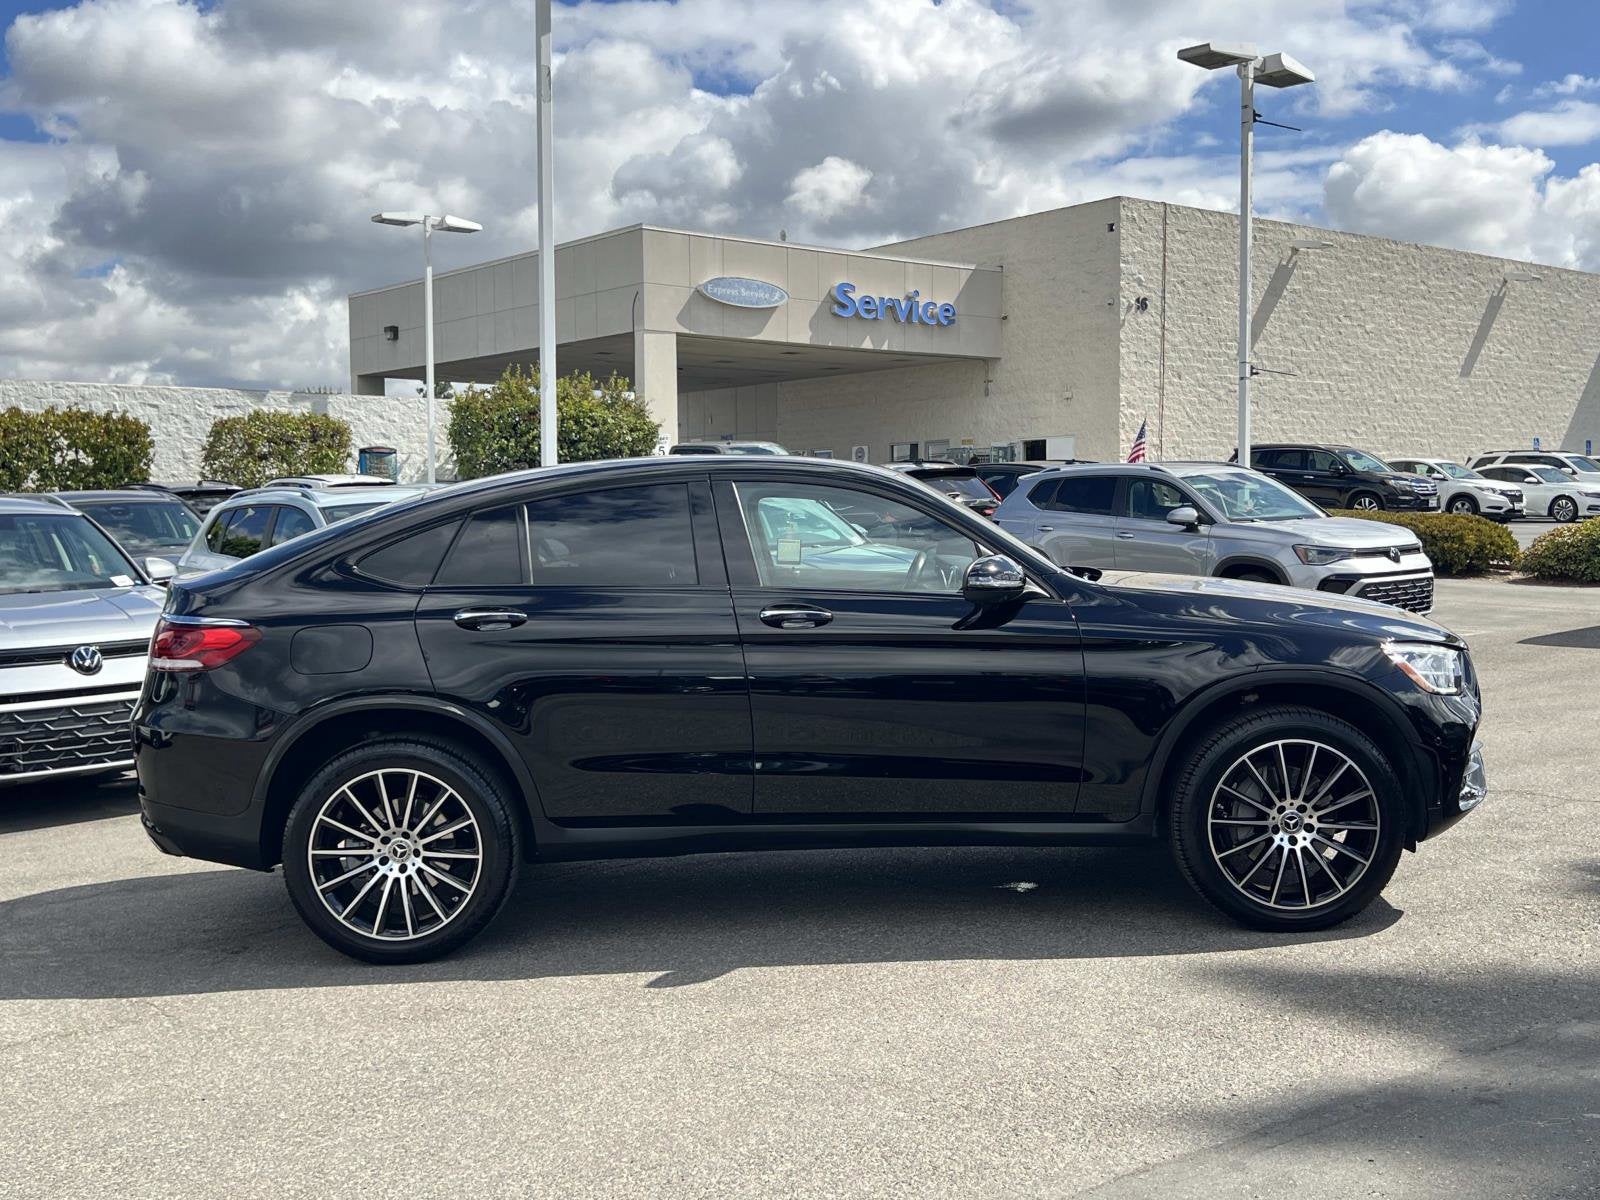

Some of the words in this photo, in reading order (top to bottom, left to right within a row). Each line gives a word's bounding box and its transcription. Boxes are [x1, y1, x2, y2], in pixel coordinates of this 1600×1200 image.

[707, 284, 739, 297] Express
[740, 288, 770, 299] Service
[833, 282, 956, 326] Service
